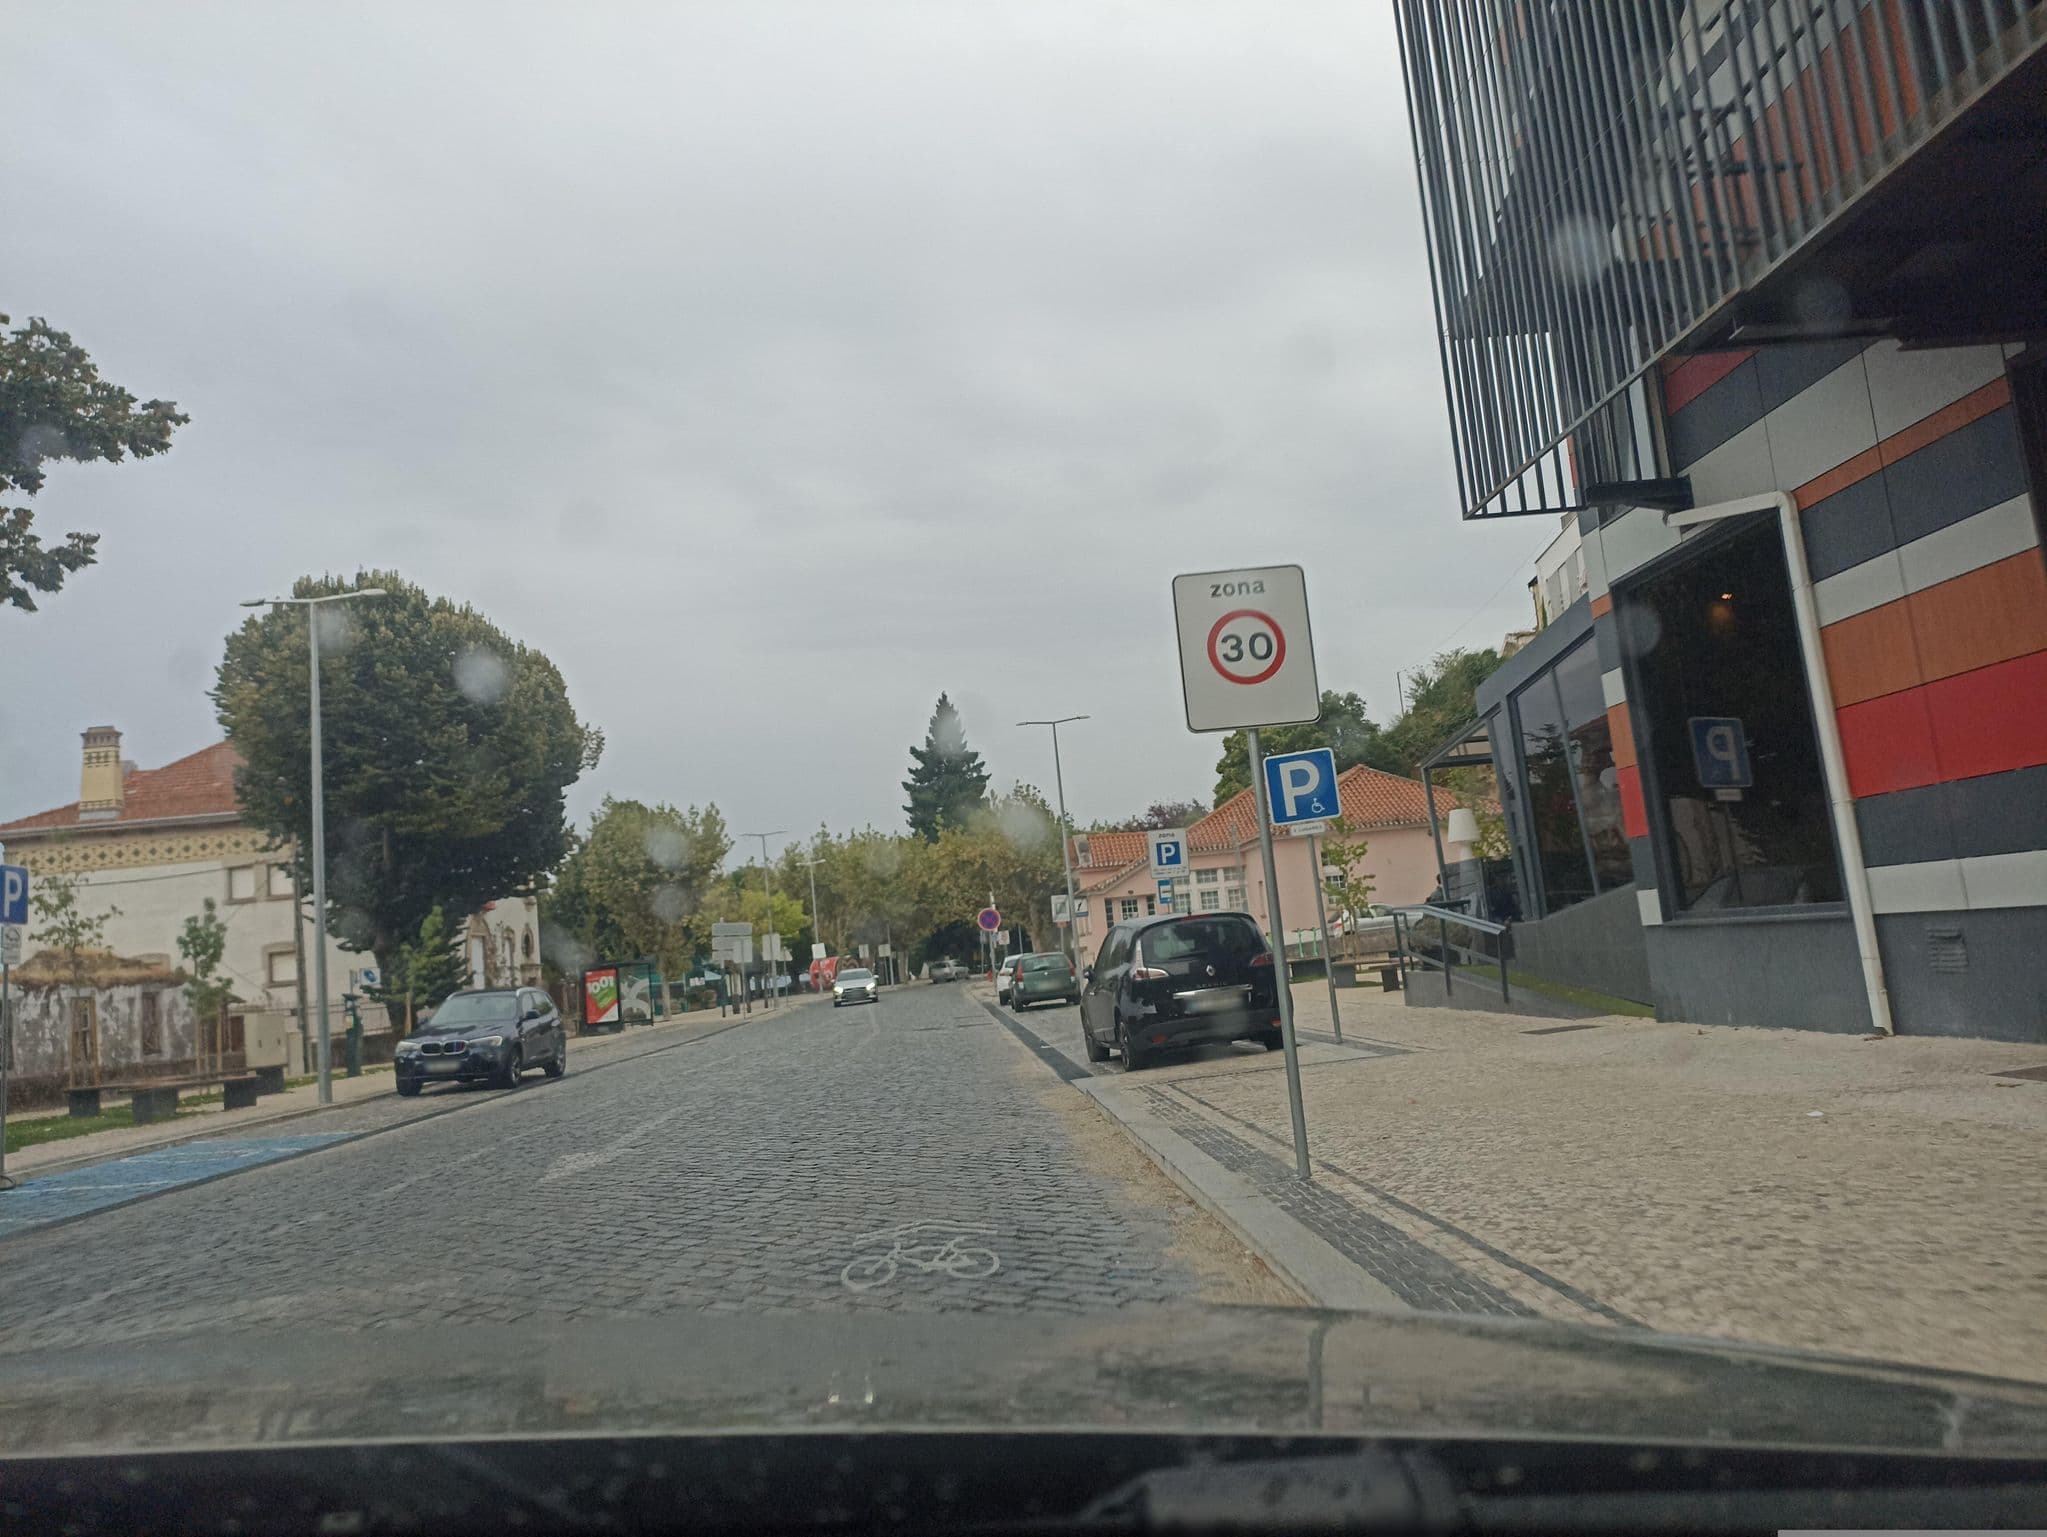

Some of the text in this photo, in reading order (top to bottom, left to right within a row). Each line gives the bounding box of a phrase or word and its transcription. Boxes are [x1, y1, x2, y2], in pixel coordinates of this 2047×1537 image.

[1209, 580, 1265, 598] zona
[1221, 631, 1273, 662] 30
[1279, 760, 1319, 816] P
[1161, 843, 1176, 864] P
[3, 870, 22, 918] P
